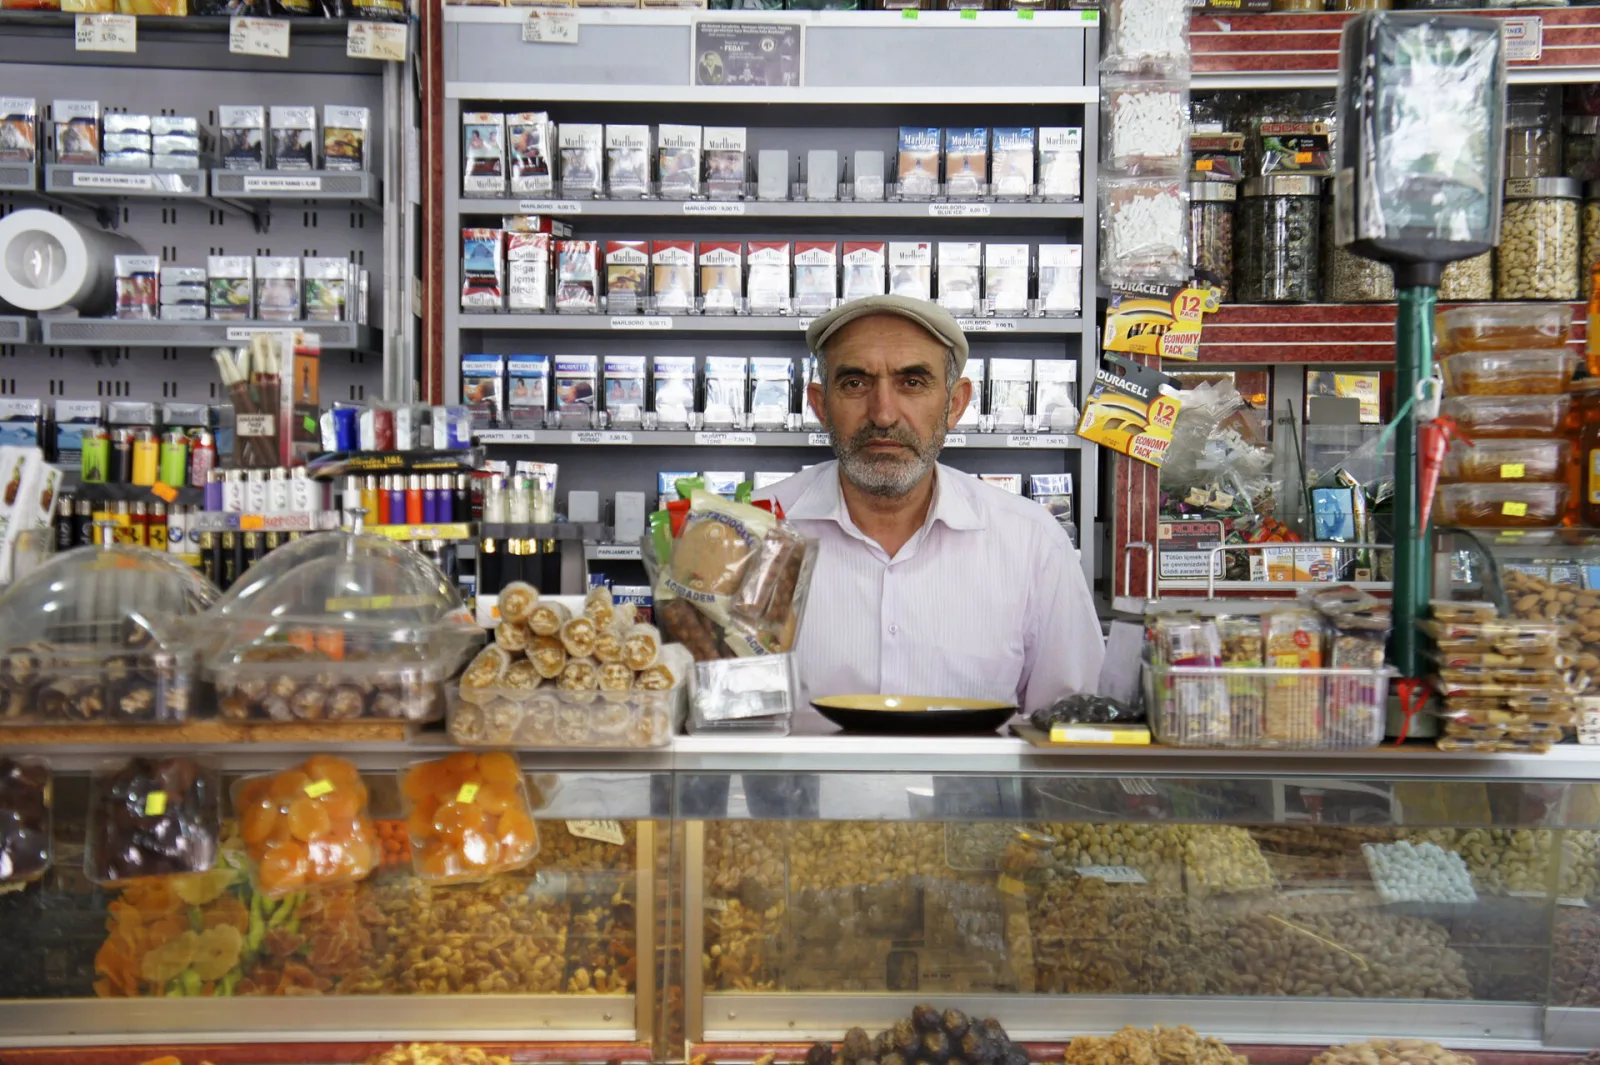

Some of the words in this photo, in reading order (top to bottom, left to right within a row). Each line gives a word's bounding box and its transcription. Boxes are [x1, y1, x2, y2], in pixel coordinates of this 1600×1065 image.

[611, 135, 644, 147] Marlboro
[664, 134, 696, 148] Marlboro
[709, 137, 741, 149] Marlboro
[904, 132, 937, 146] Marlboro
[951, 132, 984, 146] Marlboro
[998, 132, 1031, 146] Marlboro
[1045, 133, 1078, 145] Marlboro
[613, 251, 642, 262] Marlboro
[706, 252, 735, 263] Marlboro
[1111, 281, 1169, 296] DURACELL
[1182, 295, 1201, 312] 12
[1180, 310, 1199, 318] PACK
[1163, 333, 1200, 344] ECONOMY
[1164, 345, 1184, 355] PACK
[1096, 369, 1149, 399] DURACELL
[1156, 401, 1176, 421] 12
[1153, 415, 1171, 427] PACK
[1135, 435, 1169, 451] ECONOMY
[1133, 445, 1153, 459] PACK
[1183, 554, 1203, 562] içmek
